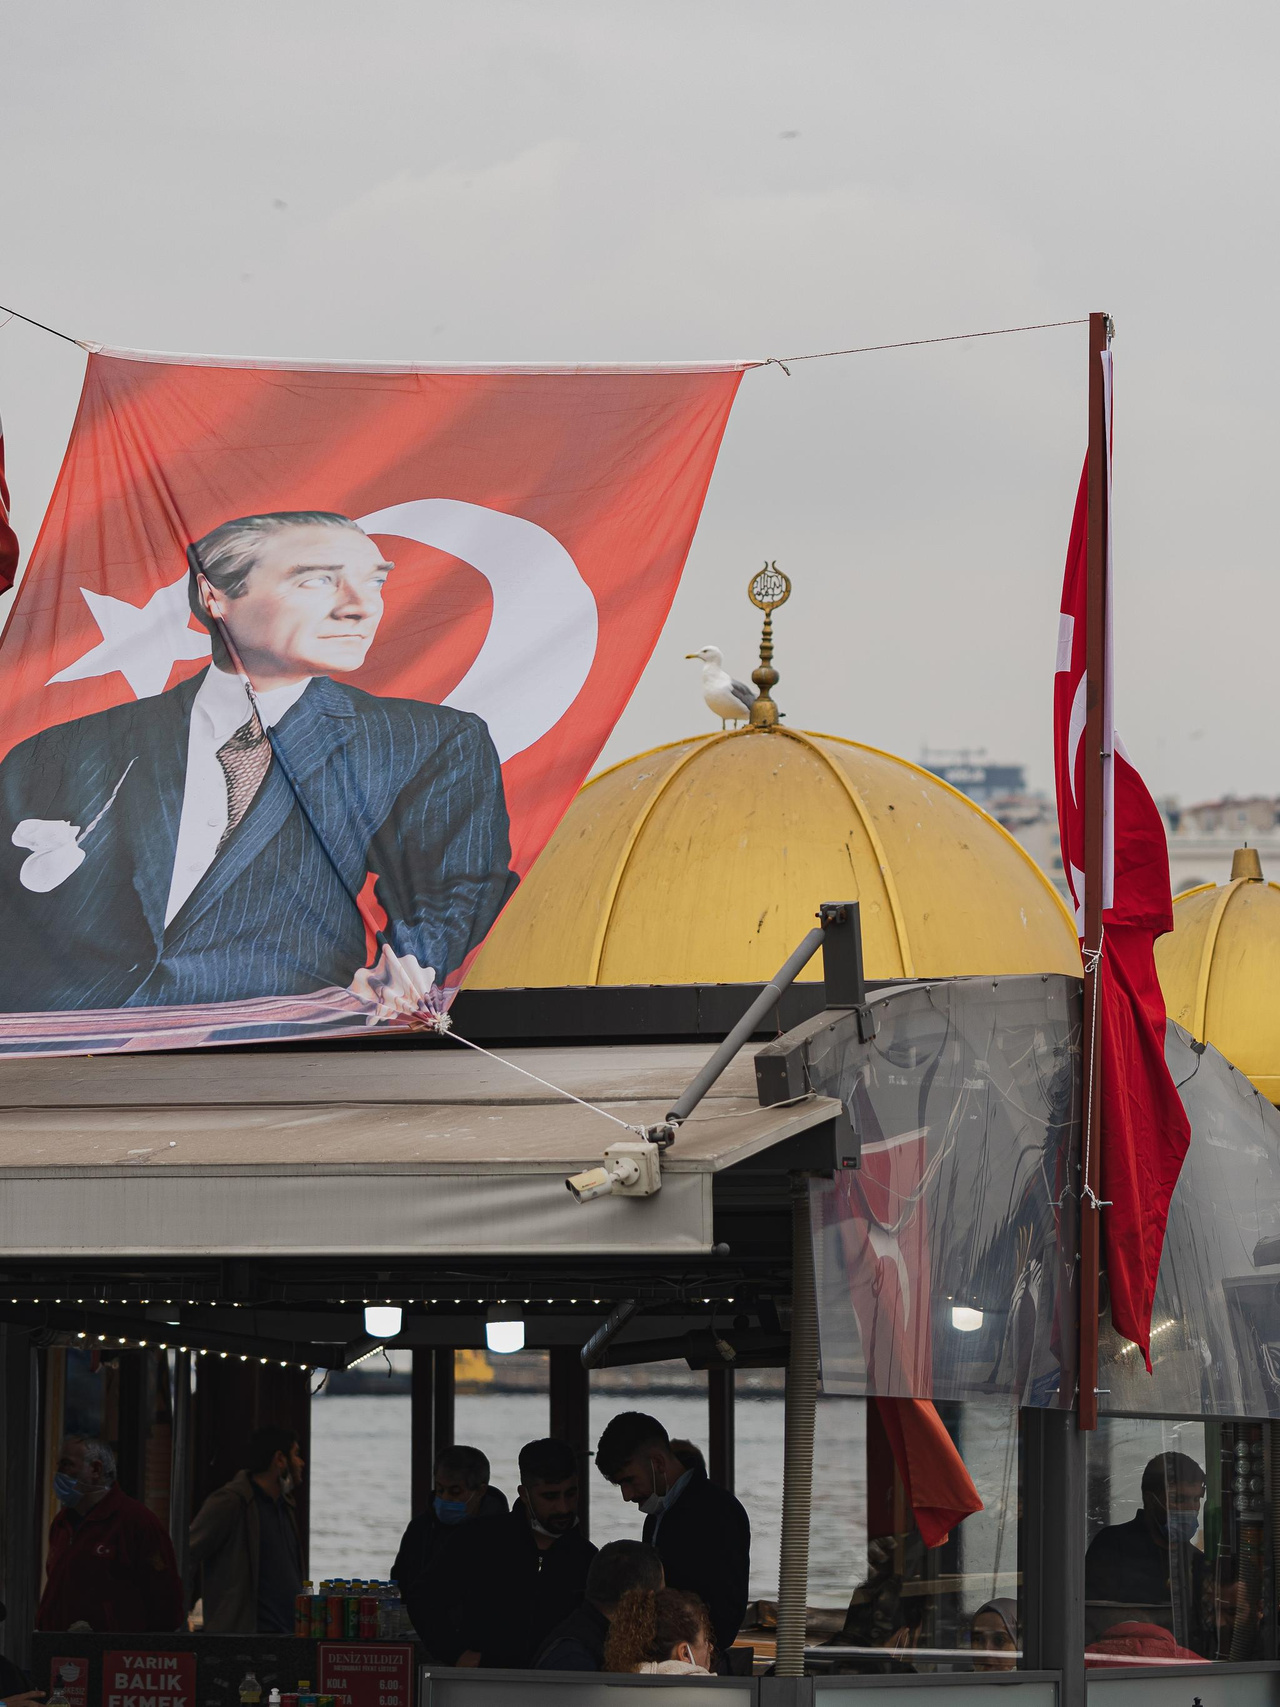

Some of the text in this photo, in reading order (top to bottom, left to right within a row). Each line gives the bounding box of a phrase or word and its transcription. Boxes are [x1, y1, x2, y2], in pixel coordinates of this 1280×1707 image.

[122, 1656, 177, 1670] YARIM
[328, 1651, 403, 1665] DENİZ YILDIZI
[114, 1672, 182, 1691] BALIK
[326, 1678, 347, 1689] KOLA
